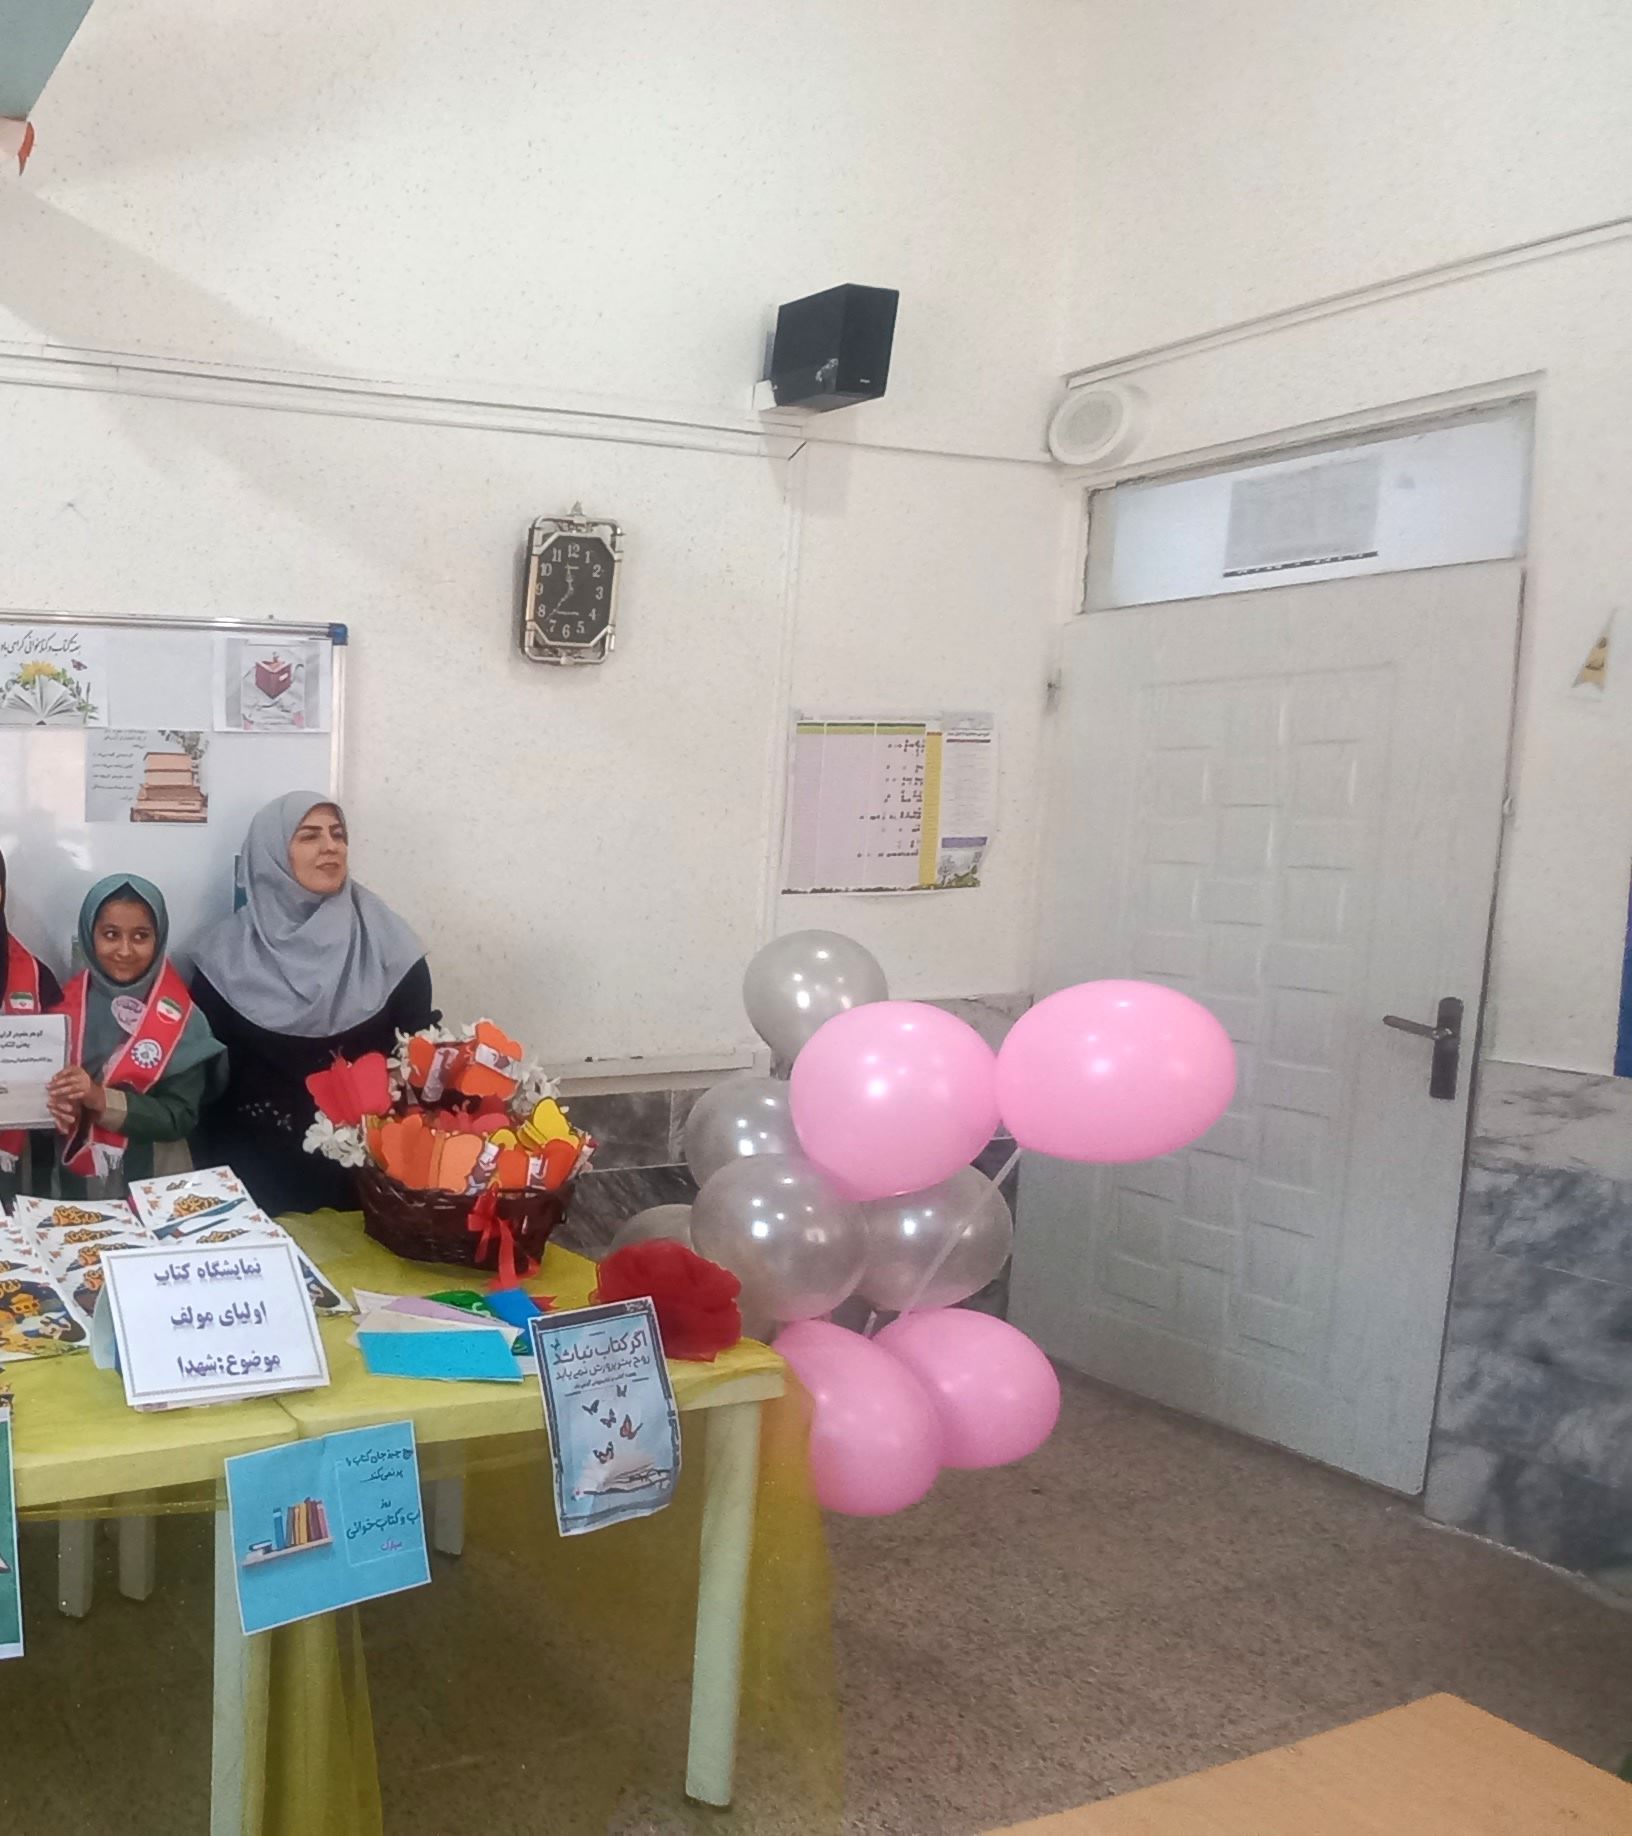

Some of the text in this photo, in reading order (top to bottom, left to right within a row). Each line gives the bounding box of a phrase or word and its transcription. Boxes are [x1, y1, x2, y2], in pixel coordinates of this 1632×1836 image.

[552, 548, 562, 563] 11
[568, 544, 581, 559] 12
[585, 551, 591, 564] 1
[540, 564, 552, 577] 10
[592, 564, 602, 578] 2
[535, 582, 544, 595] 9
[595, 586, 604, 600] 3
[537, 604, 546, 618] 8
[588, 608, 597, 621] 4
[549, 620, 557, 633] 7
[562, 624, 571, 639] 6
[576, 621, 585, 634] 5
[154, 1258, 262, 1286] نمایشگاه کتاب
[171, 1301, 268, 1330] اولیای مولف
[553, 1330, 647, 1365] اگر کتاب نباشد
[633, 1355, 650, 1368] روح
[380, 1499, 392, 1509] روز
